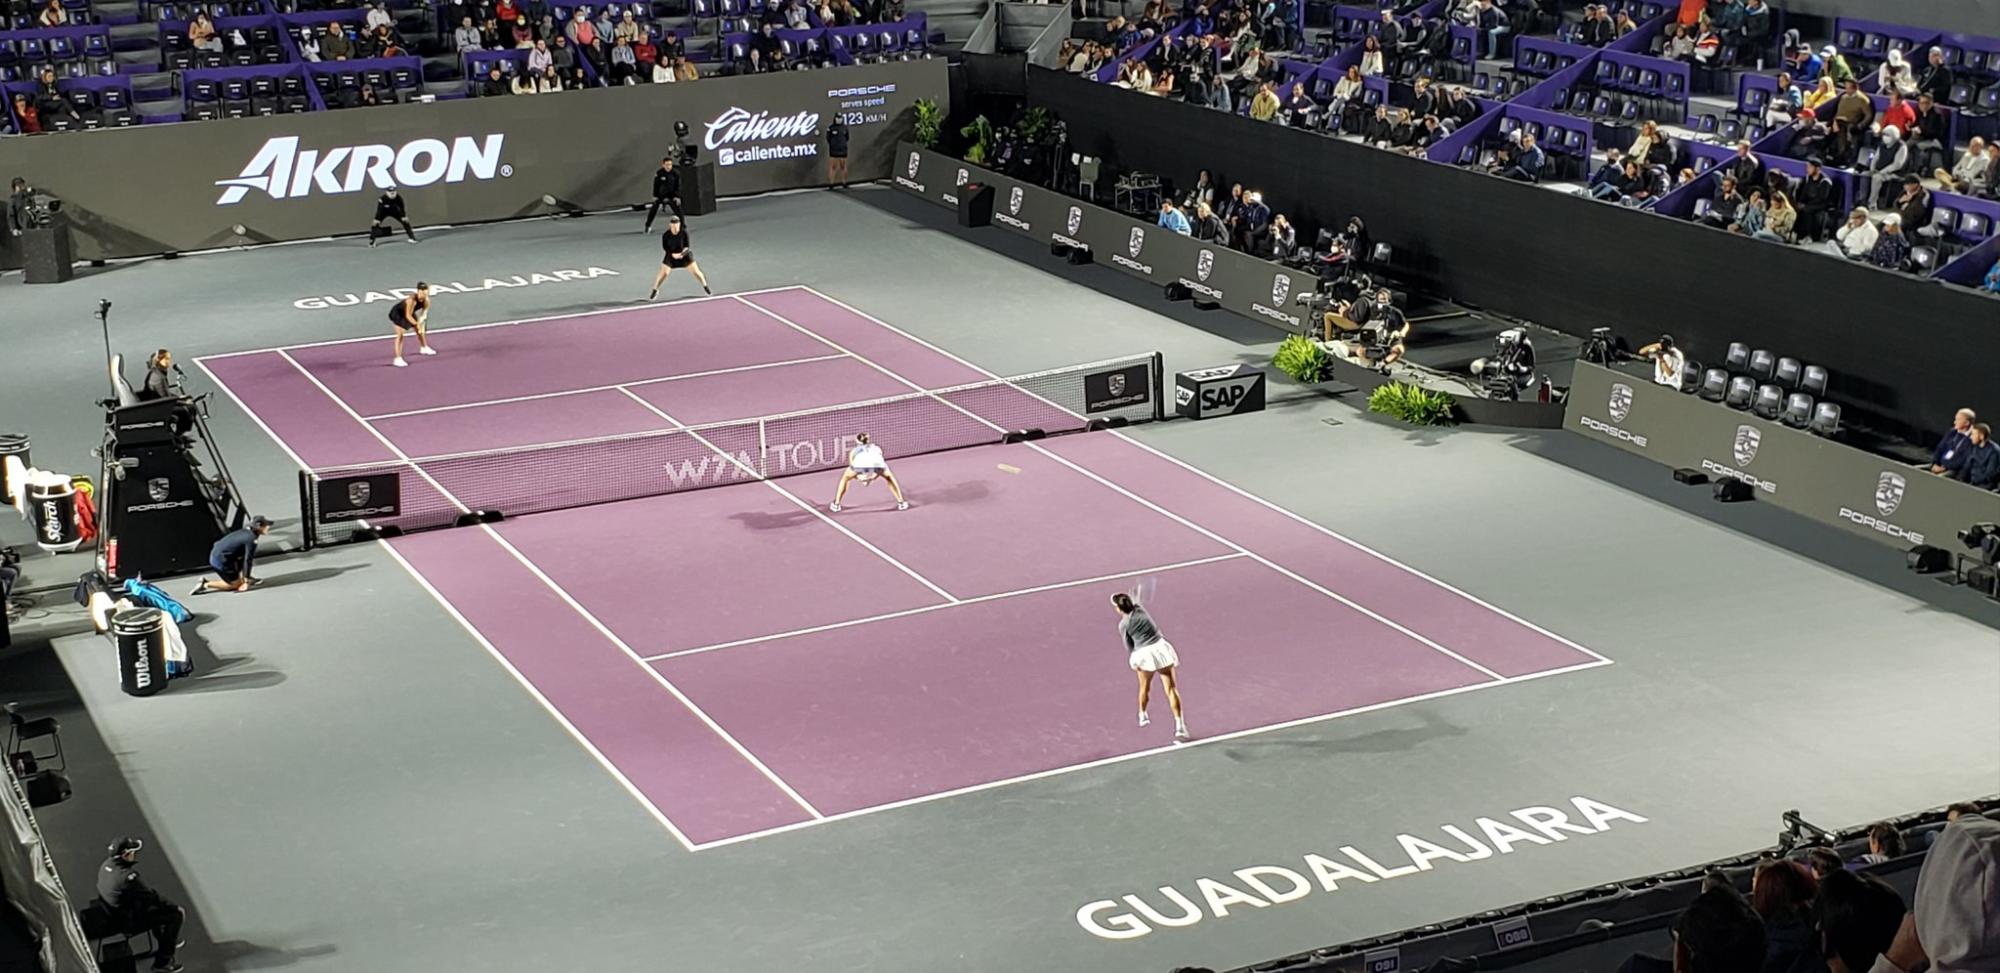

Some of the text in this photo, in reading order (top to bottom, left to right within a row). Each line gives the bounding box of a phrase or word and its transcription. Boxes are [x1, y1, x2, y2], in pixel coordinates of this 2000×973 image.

[828, 84, 896, 97] PORSCHE
[841, 96, 885, 109] serves speed
[704, 106, 820, 150] Caliente
[842, 112, 887, 125] 123 KM/H
[735, 143, 817, 163] caliente.mx
[214, 133, 504, 205] AKRON
[896, 176, 925, 192] PORSCHE
[995, 212, 1030, 231] PORSCHE
[1112, 254, 1153, 275] PORSCHE
[1179, 277, 1223, 300] PORSCHE
[1252, 303, 1300, 326] PORSCHE
[1091, 394, 1145, 409] PORSCHE
[1201, 385, 1245, 410] SAP
[120, 421, 165, 430] PORSCHE
[1580, 415, 1647, 447] PORSCHE
[1702, 459, 1776, 494] PORSCHE
[127, 500, 194, 513] PORSCHE
[326, 506, 395, 518] PORSCHE
[1839, 507, 1925, 544] PORSCHE
[134, 637, 152, 689] Wilson
[1075, 796, 1649, 940] GUADALAJARA
